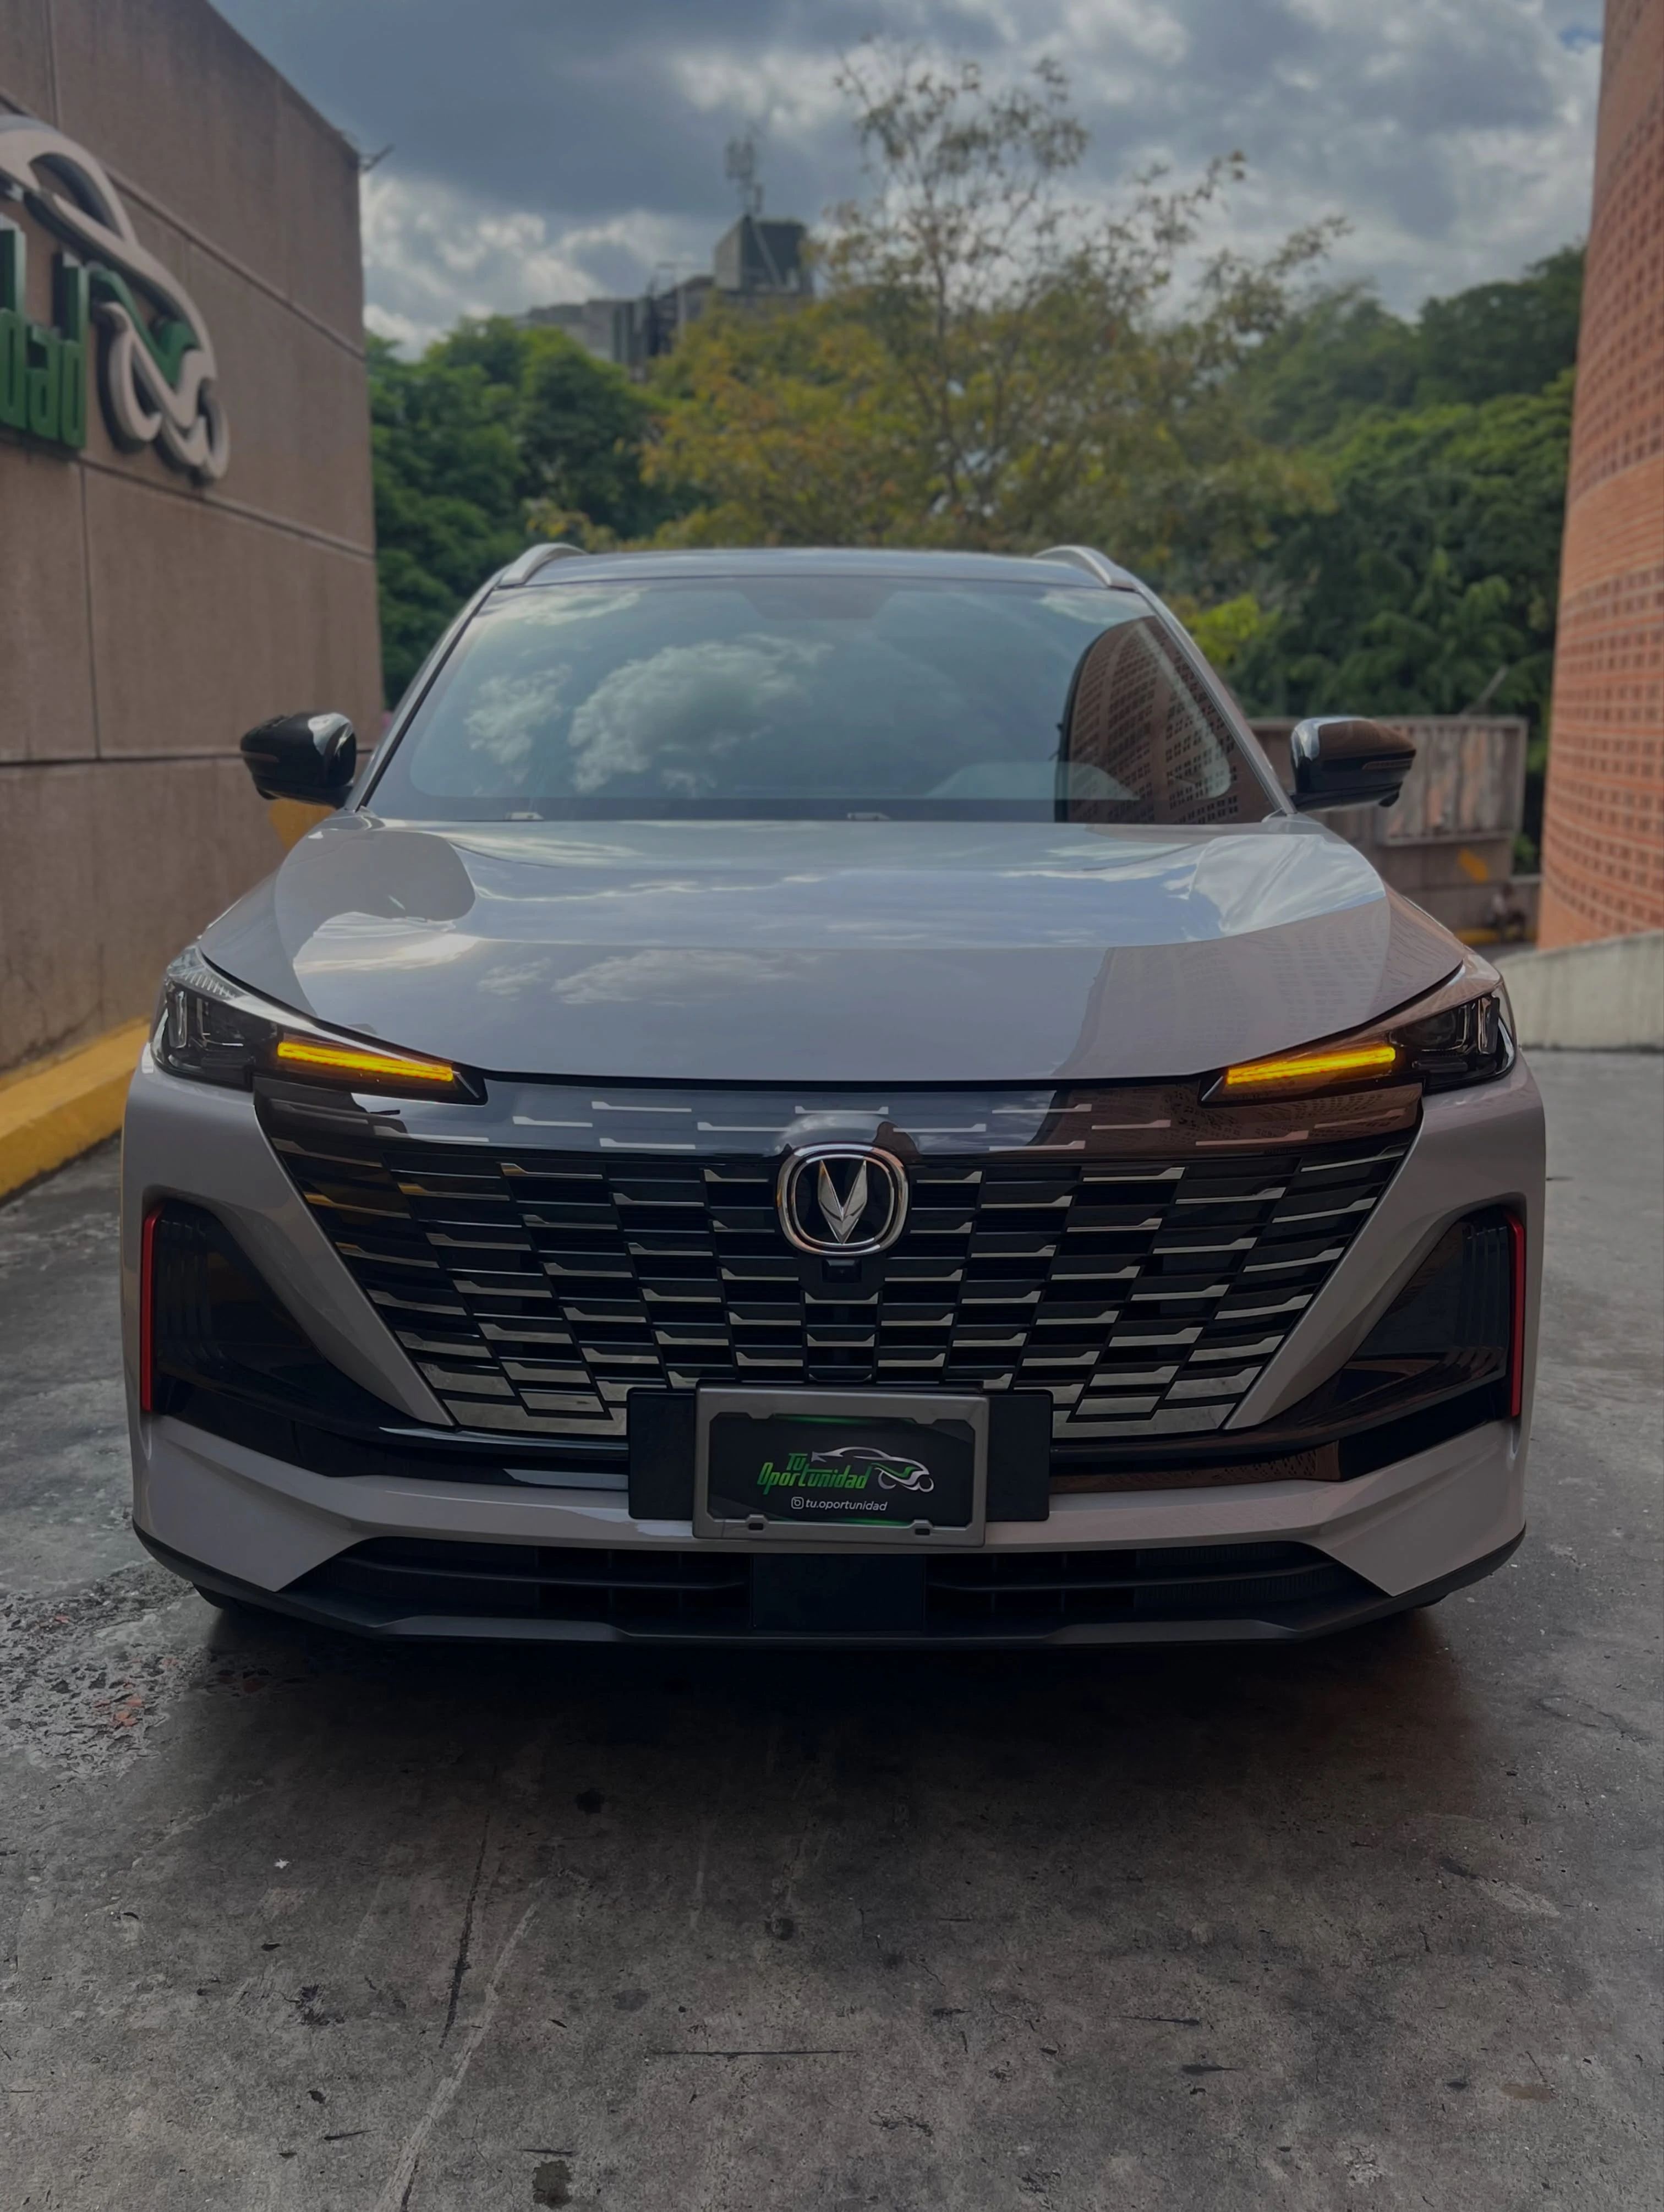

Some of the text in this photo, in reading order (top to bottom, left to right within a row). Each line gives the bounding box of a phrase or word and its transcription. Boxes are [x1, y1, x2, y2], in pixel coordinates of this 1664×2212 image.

[786, 1452, 808, 1471] Tu
[757, 1461, 872, 1495] Oportunidad
[805, 1499, 888, 1511] tu.oportunidad
